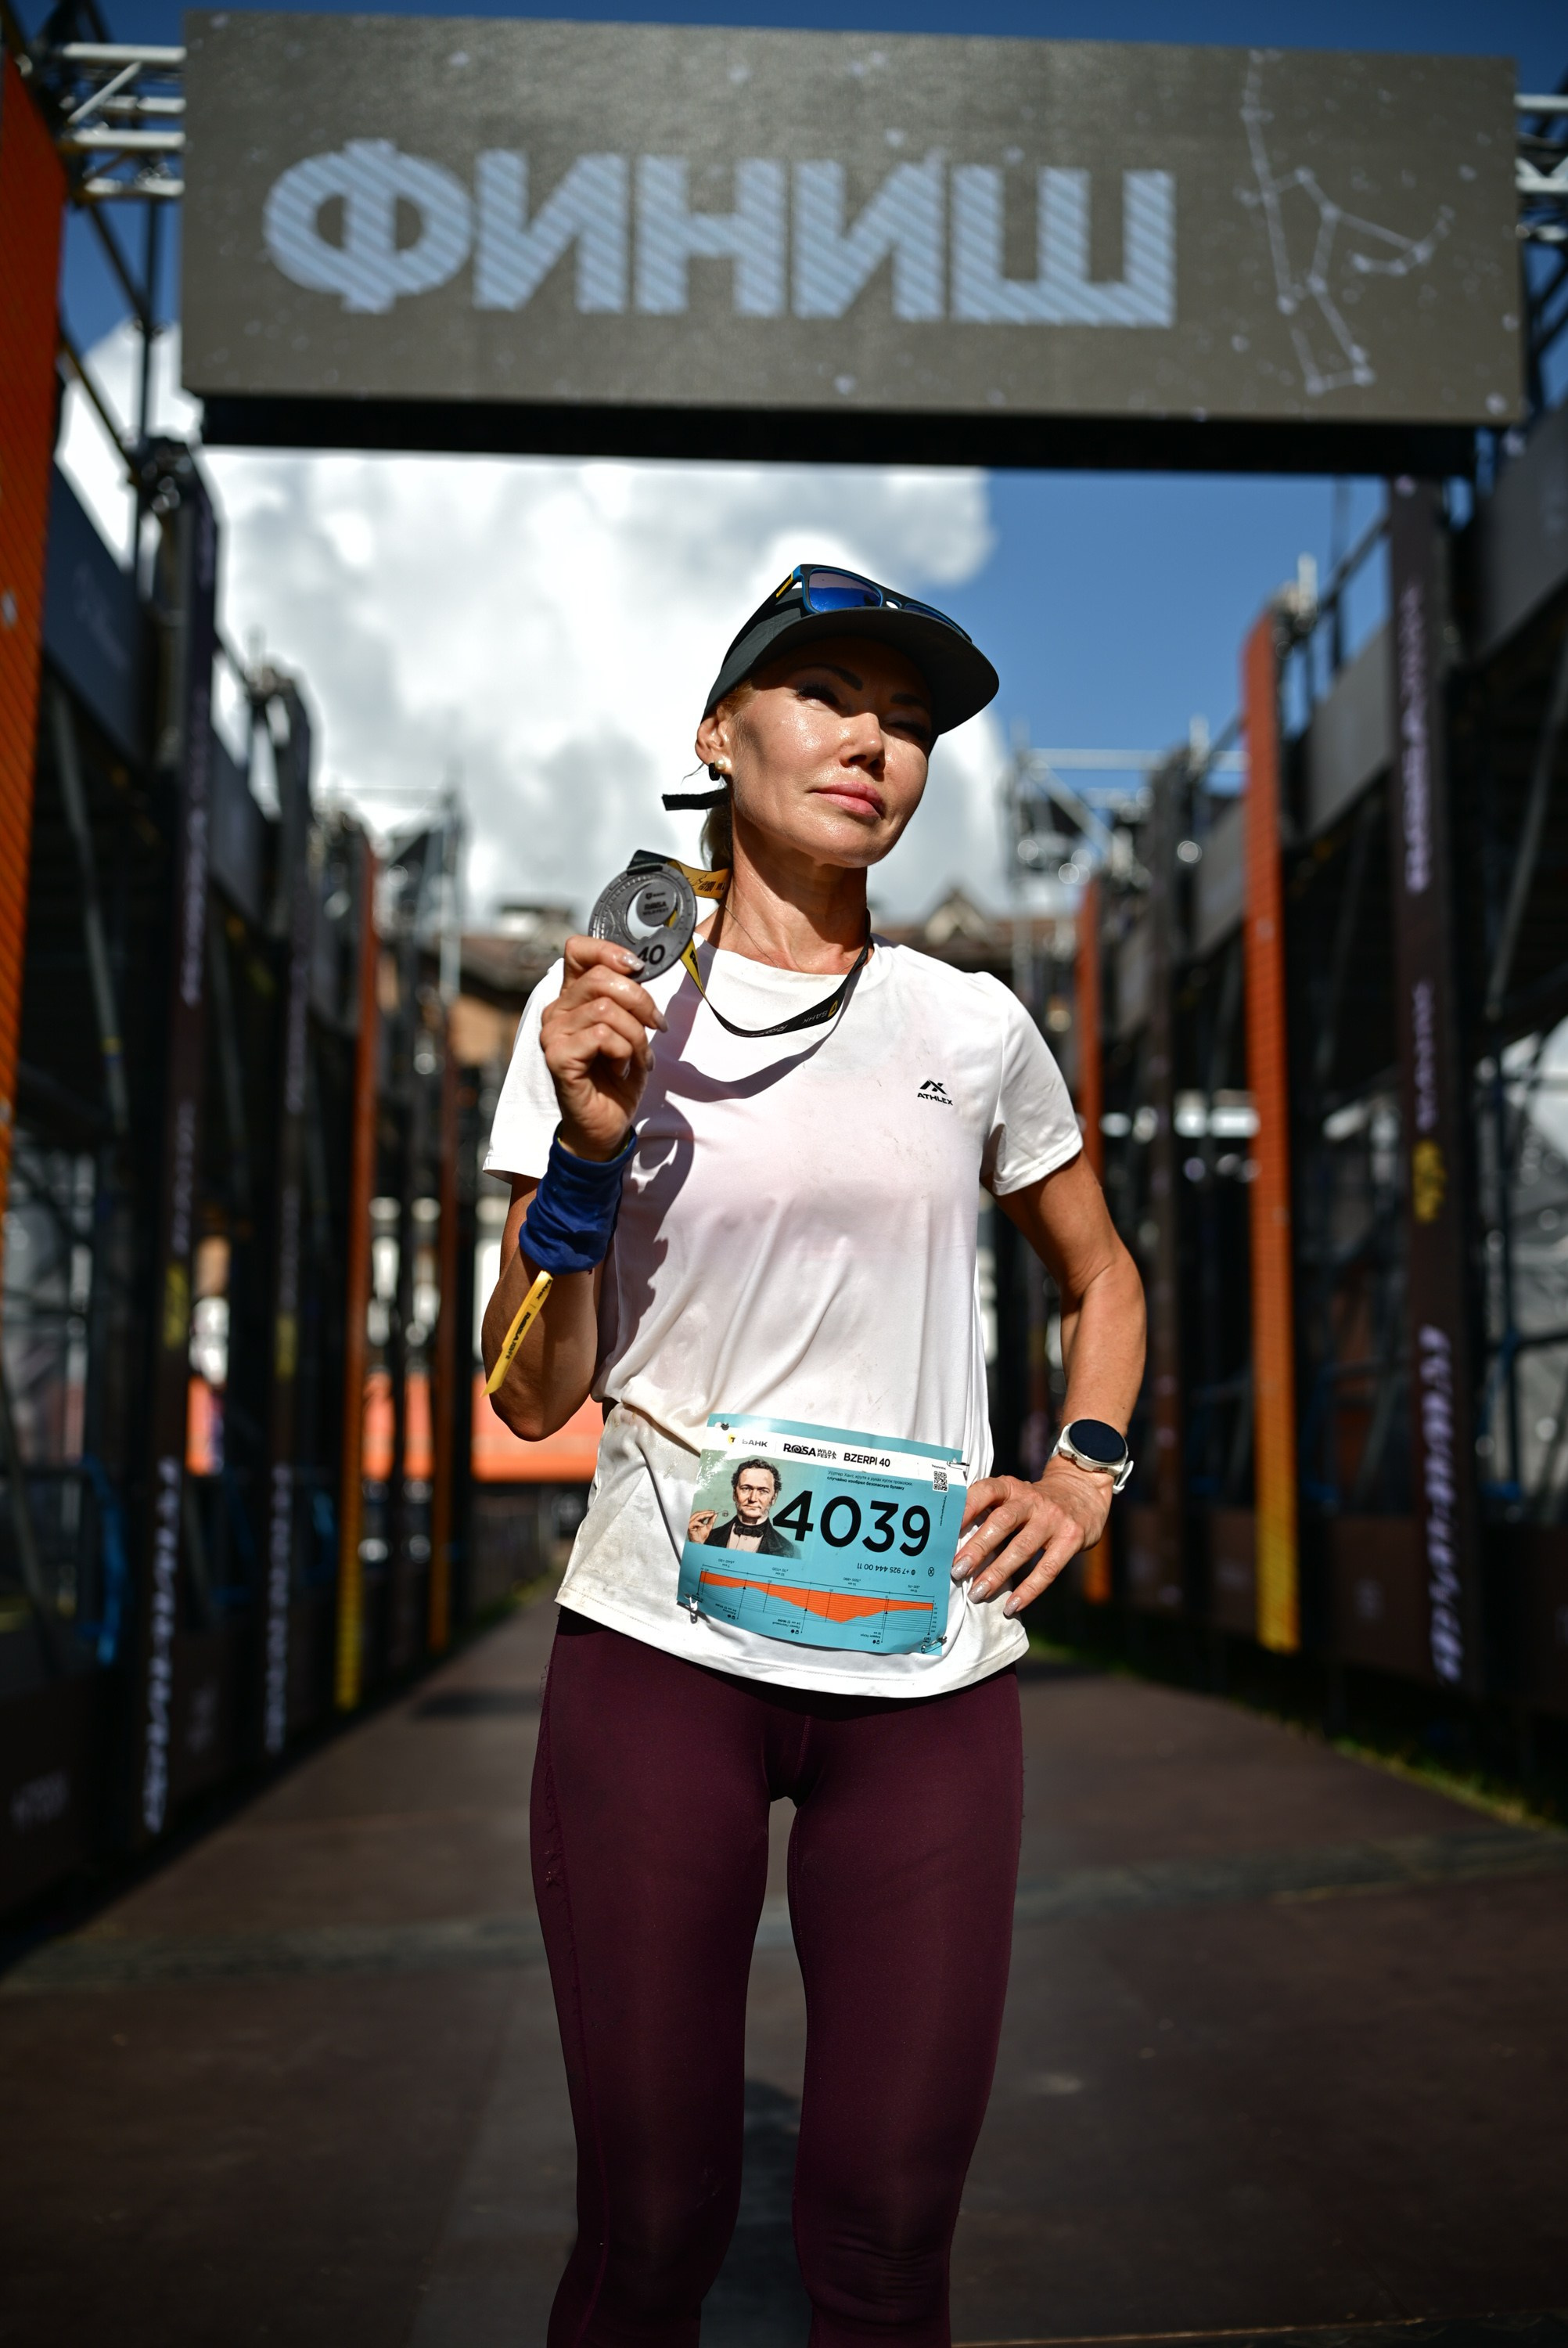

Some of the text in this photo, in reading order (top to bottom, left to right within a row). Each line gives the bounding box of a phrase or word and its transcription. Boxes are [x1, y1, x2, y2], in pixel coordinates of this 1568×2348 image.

[263, 139, 1173, 329] ФИНИШ
[917, 1093, 953, 1106] ATHLEX
[783, 1443, 816, 1457] ROSA
[843, 1453, 890, 1468] BZERPI 40
[772, 1490, 931, 1557] 4039
